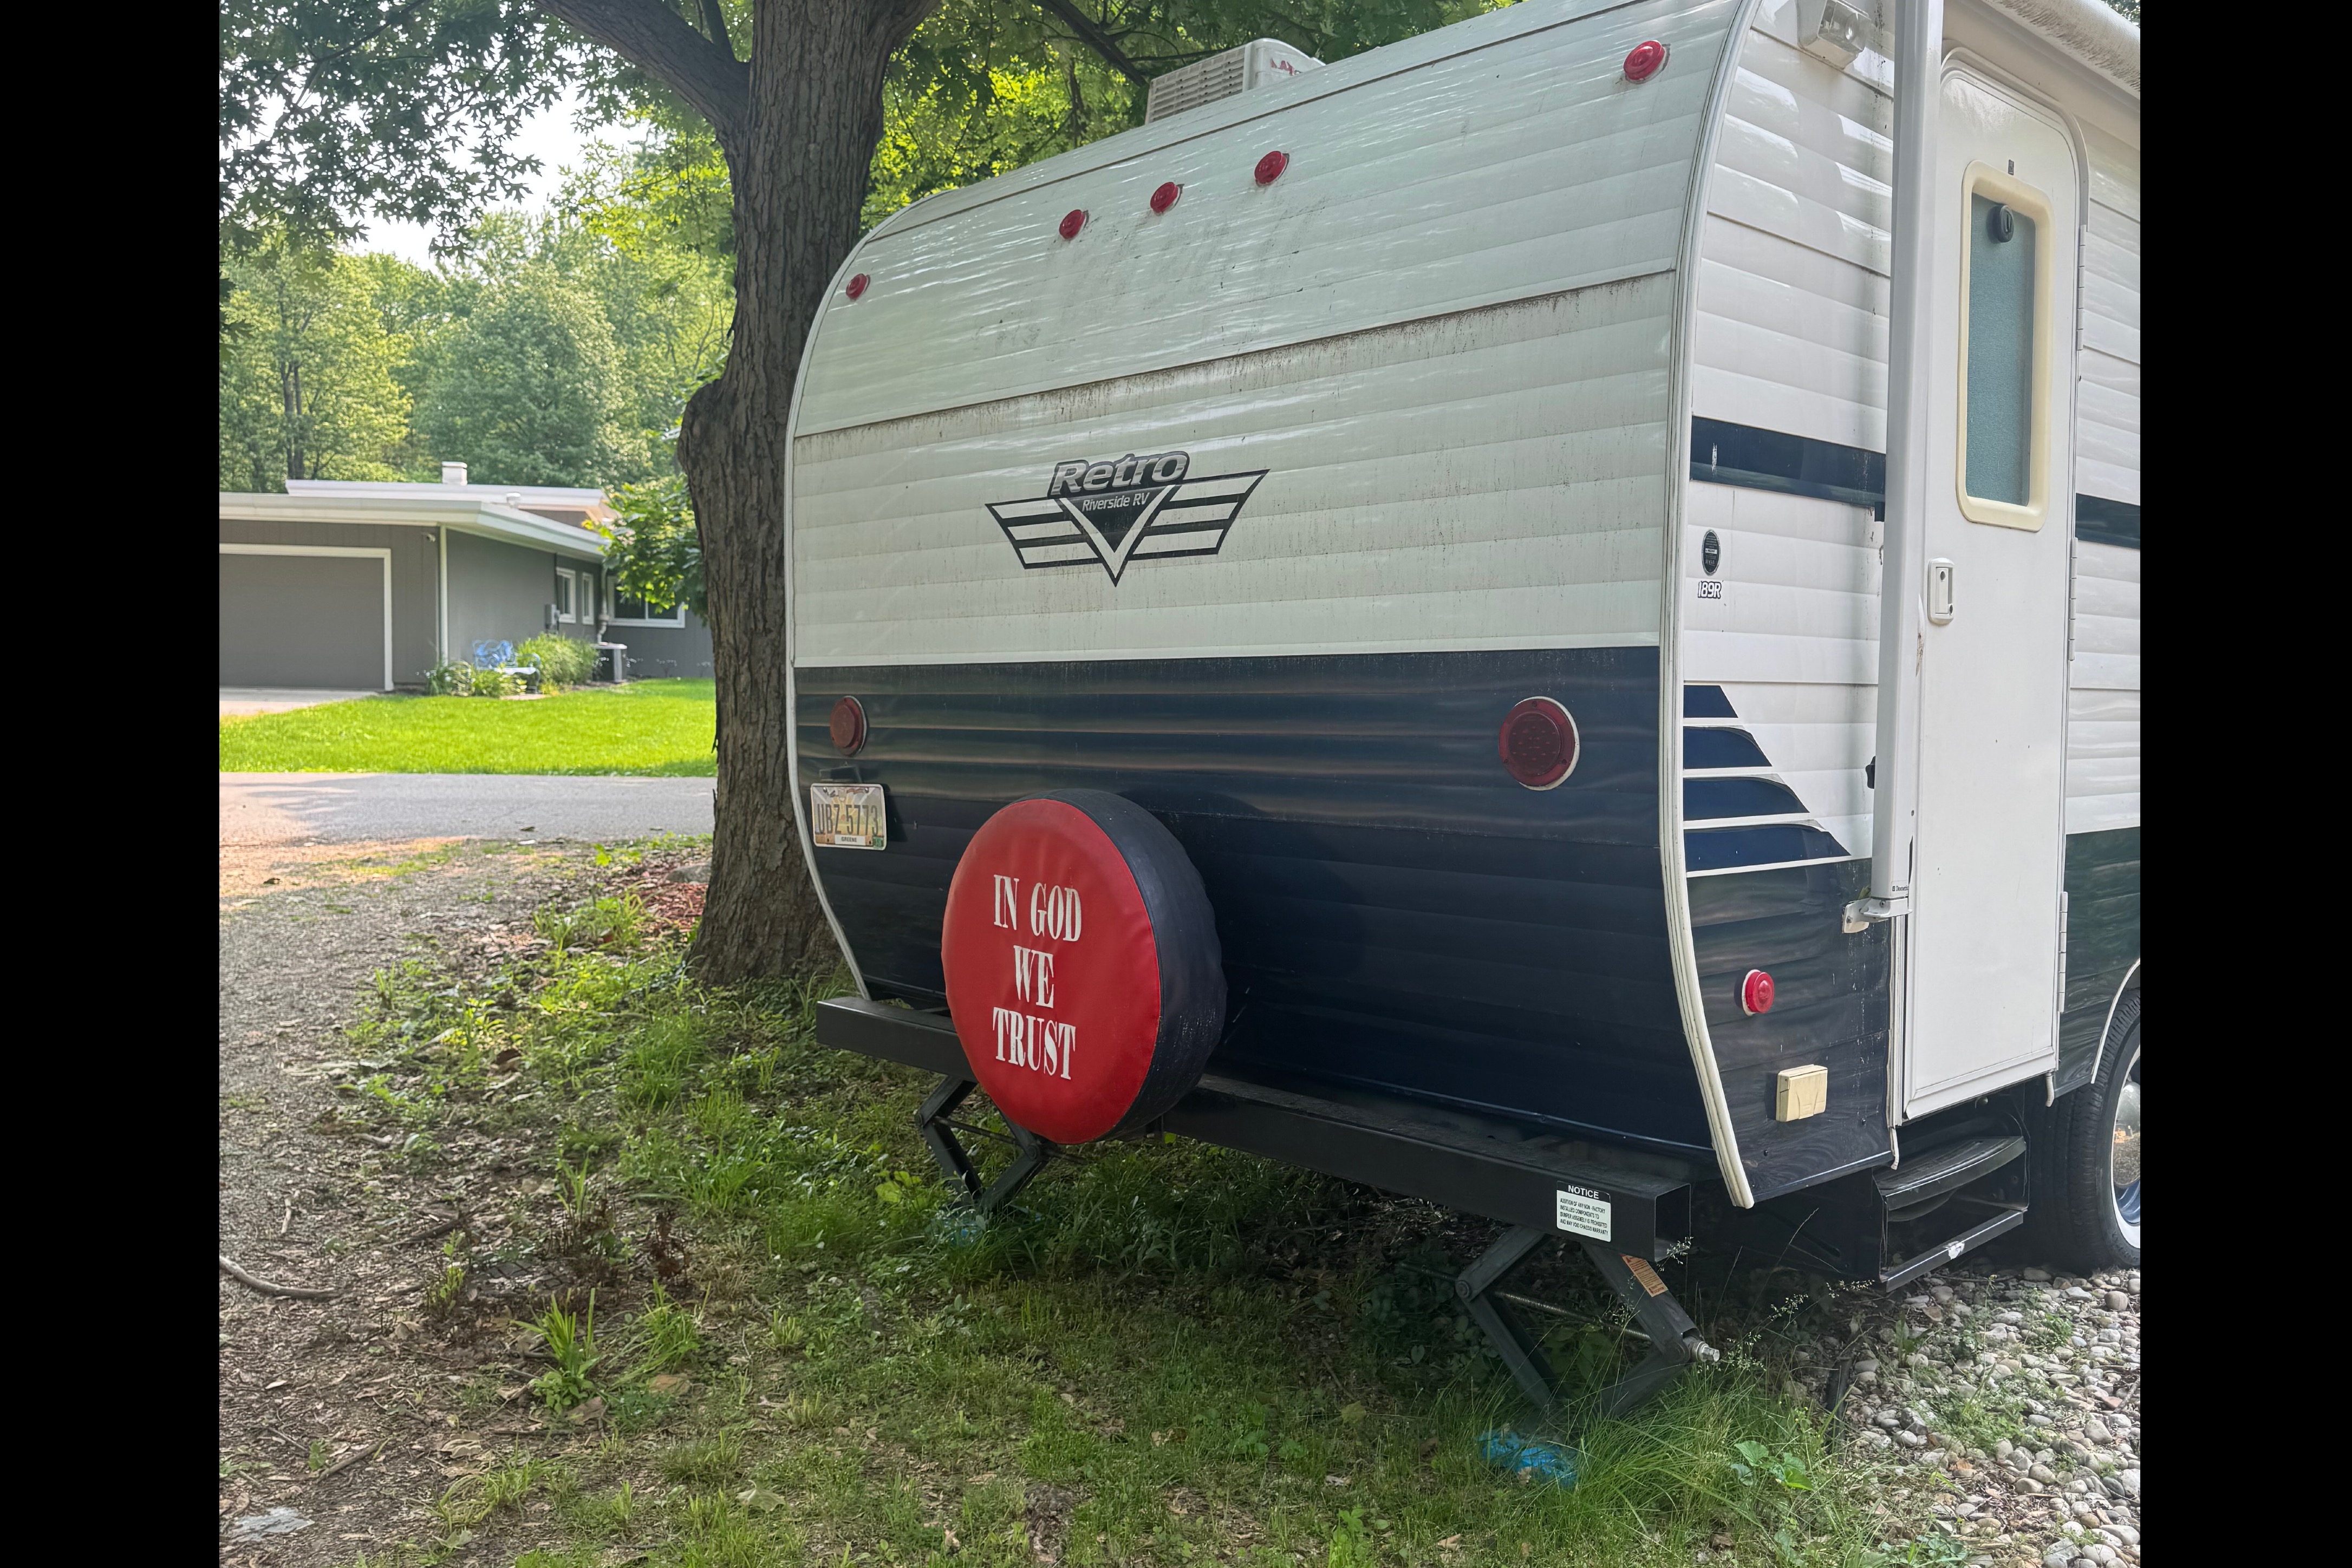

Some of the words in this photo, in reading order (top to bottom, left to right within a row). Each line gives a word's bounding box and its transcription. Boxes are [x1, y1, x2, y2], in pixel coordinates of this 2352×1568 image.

[1050, 453, 1188, 496] Retro
[1082, 495, 1130, 512] Riverside
[1133, 492, 1150, 506] RV
[1697, 581, 1722, 599] 189R
[817, 803, 842, 834] UBZ
[845, 804, 878, 836] 5773
[993, 874, 1020, 931] IN
[1030, 882, 1082, 942] GOD
[1013, 945, 1054, 1009] WE
[992, 1007, 1076, 1080] TRUST
[1568, 1185, 1599, 1199] NOTICE
